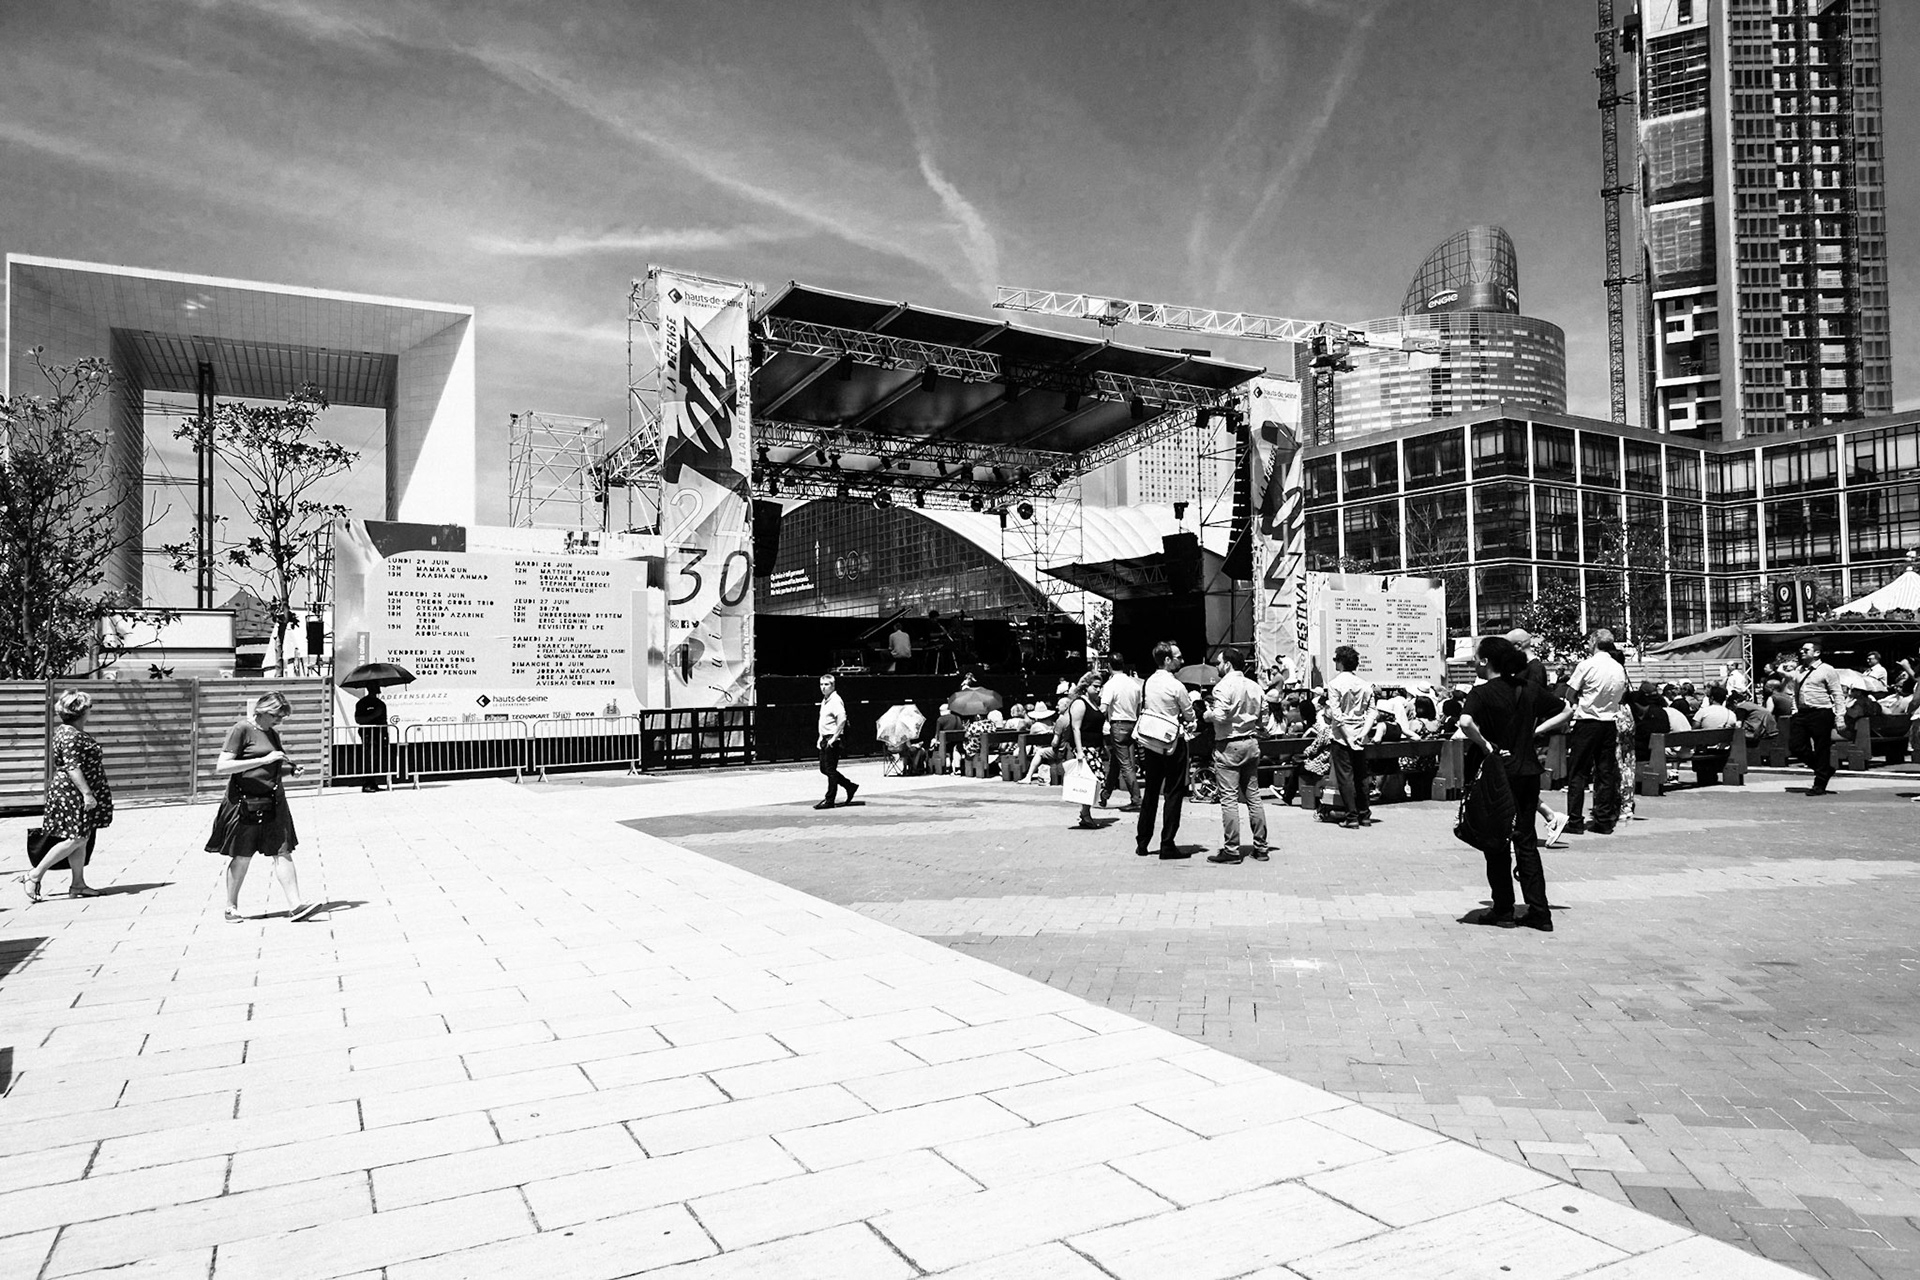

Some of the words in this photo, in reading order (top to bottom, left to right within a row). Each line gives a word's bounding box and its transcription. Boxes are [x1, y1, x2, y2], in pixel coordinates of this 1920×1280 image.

[666, 376, 677, 394] LA
[668, 548, 750, 606] 30
[1296, 573, 1308, 652] FESTIVAL
